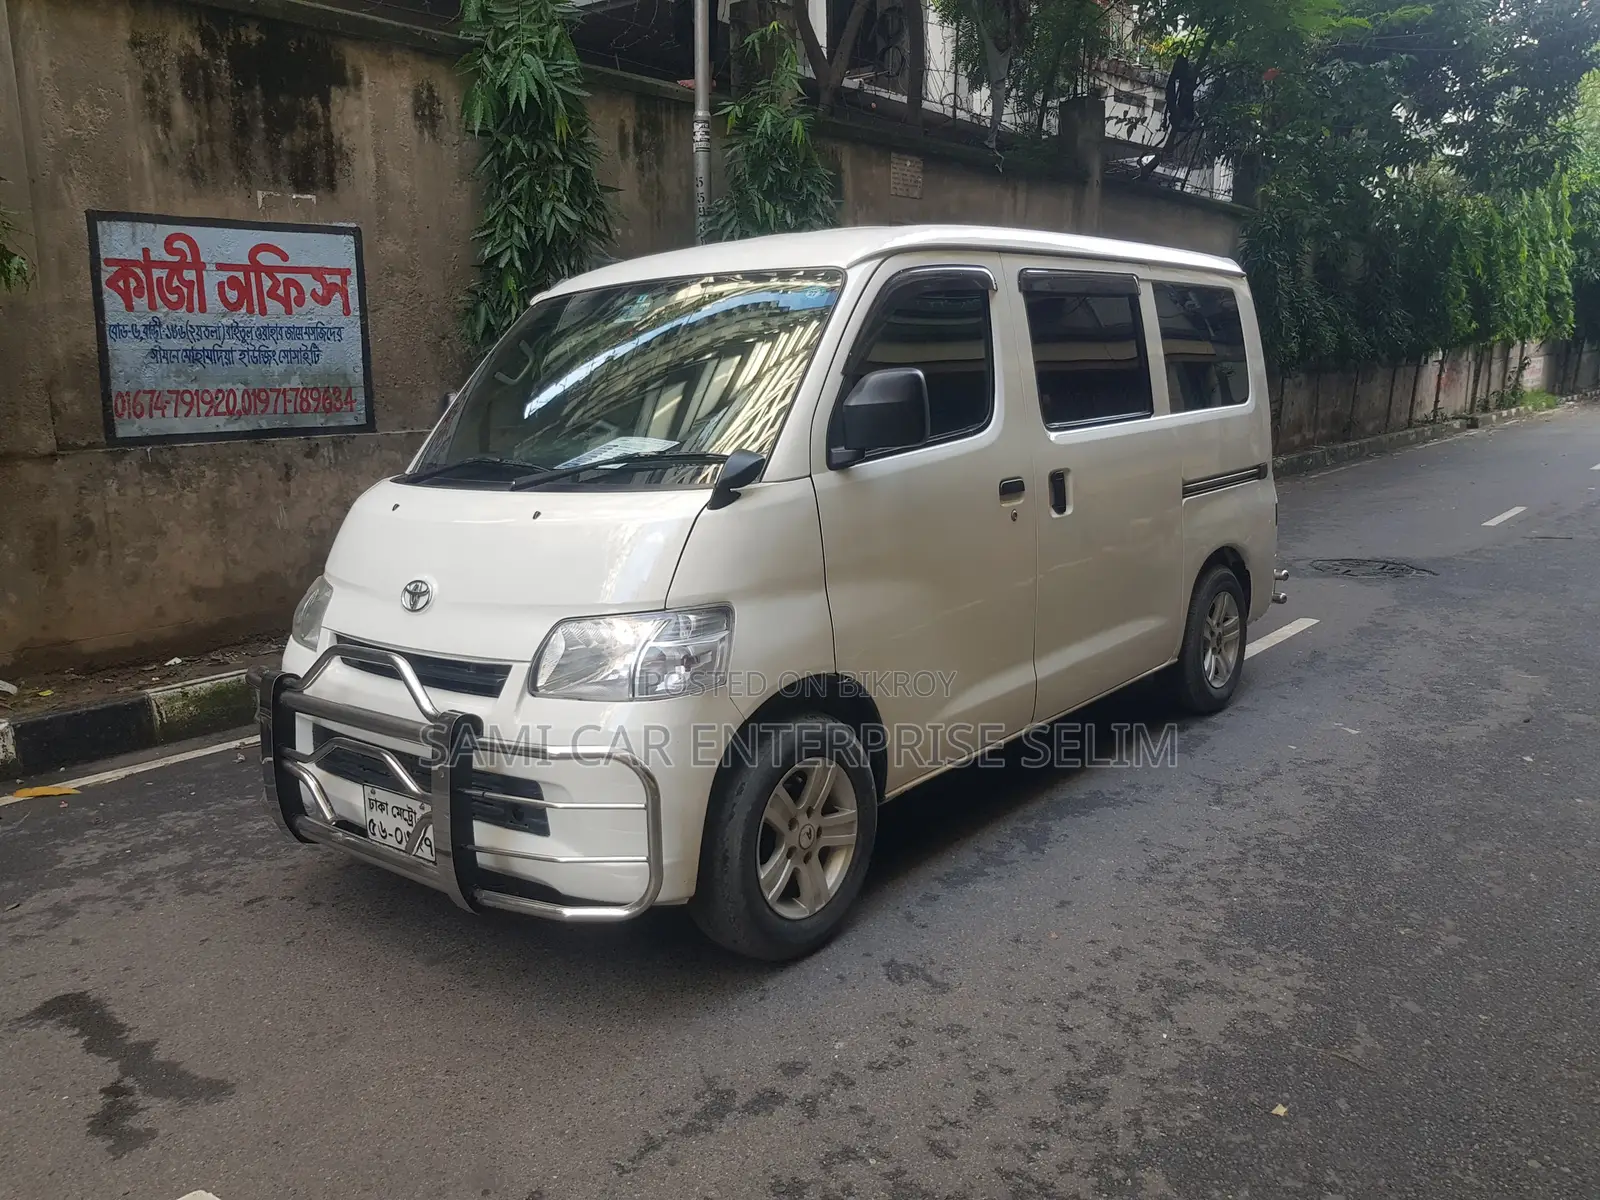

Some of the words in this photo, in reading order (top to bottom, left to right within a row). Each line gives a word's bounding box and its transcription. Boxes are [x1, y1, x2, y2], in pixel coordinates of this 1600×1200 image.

[104, 232, 207, 314] কাজী
[215, 243, 352, 317] অফিস
[368, 797, 389, 816] ঢাকা
[368, 818, 434, 857] ৫৬-০৭
